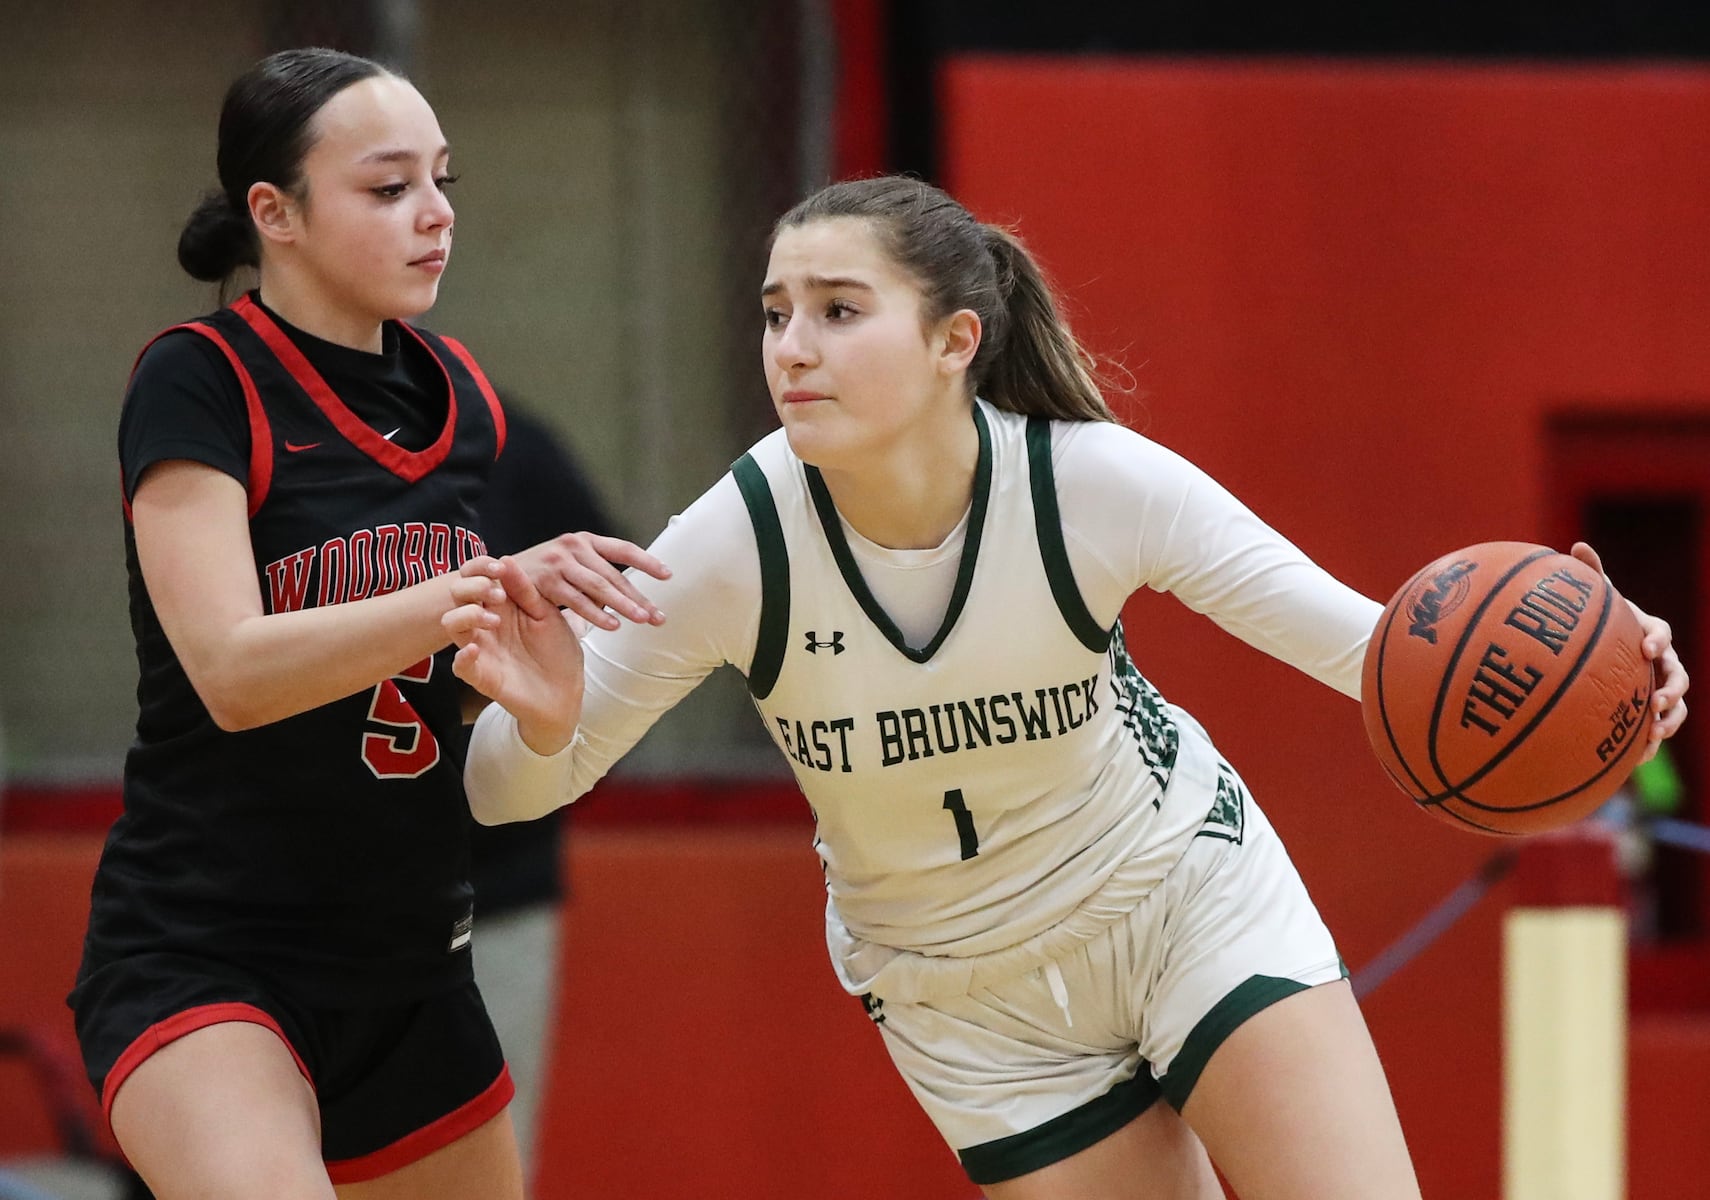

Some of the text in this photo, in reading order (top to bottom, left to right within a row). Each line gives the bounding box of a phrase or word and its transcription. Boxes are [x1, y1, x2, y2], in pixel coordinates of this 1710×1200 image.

[265, 522, 488, 616] WOODBRI
[1460, 568, 1593, 738] THE ROCK
[361, 655, 440, 779] 5
[775, 674, 1099, 773] EAST BRUNSWICK
[1596, 687, 1644, 762] ROCK
[1610, 699, 1629, 724] THE
[943, 789, 979, 860] 1
